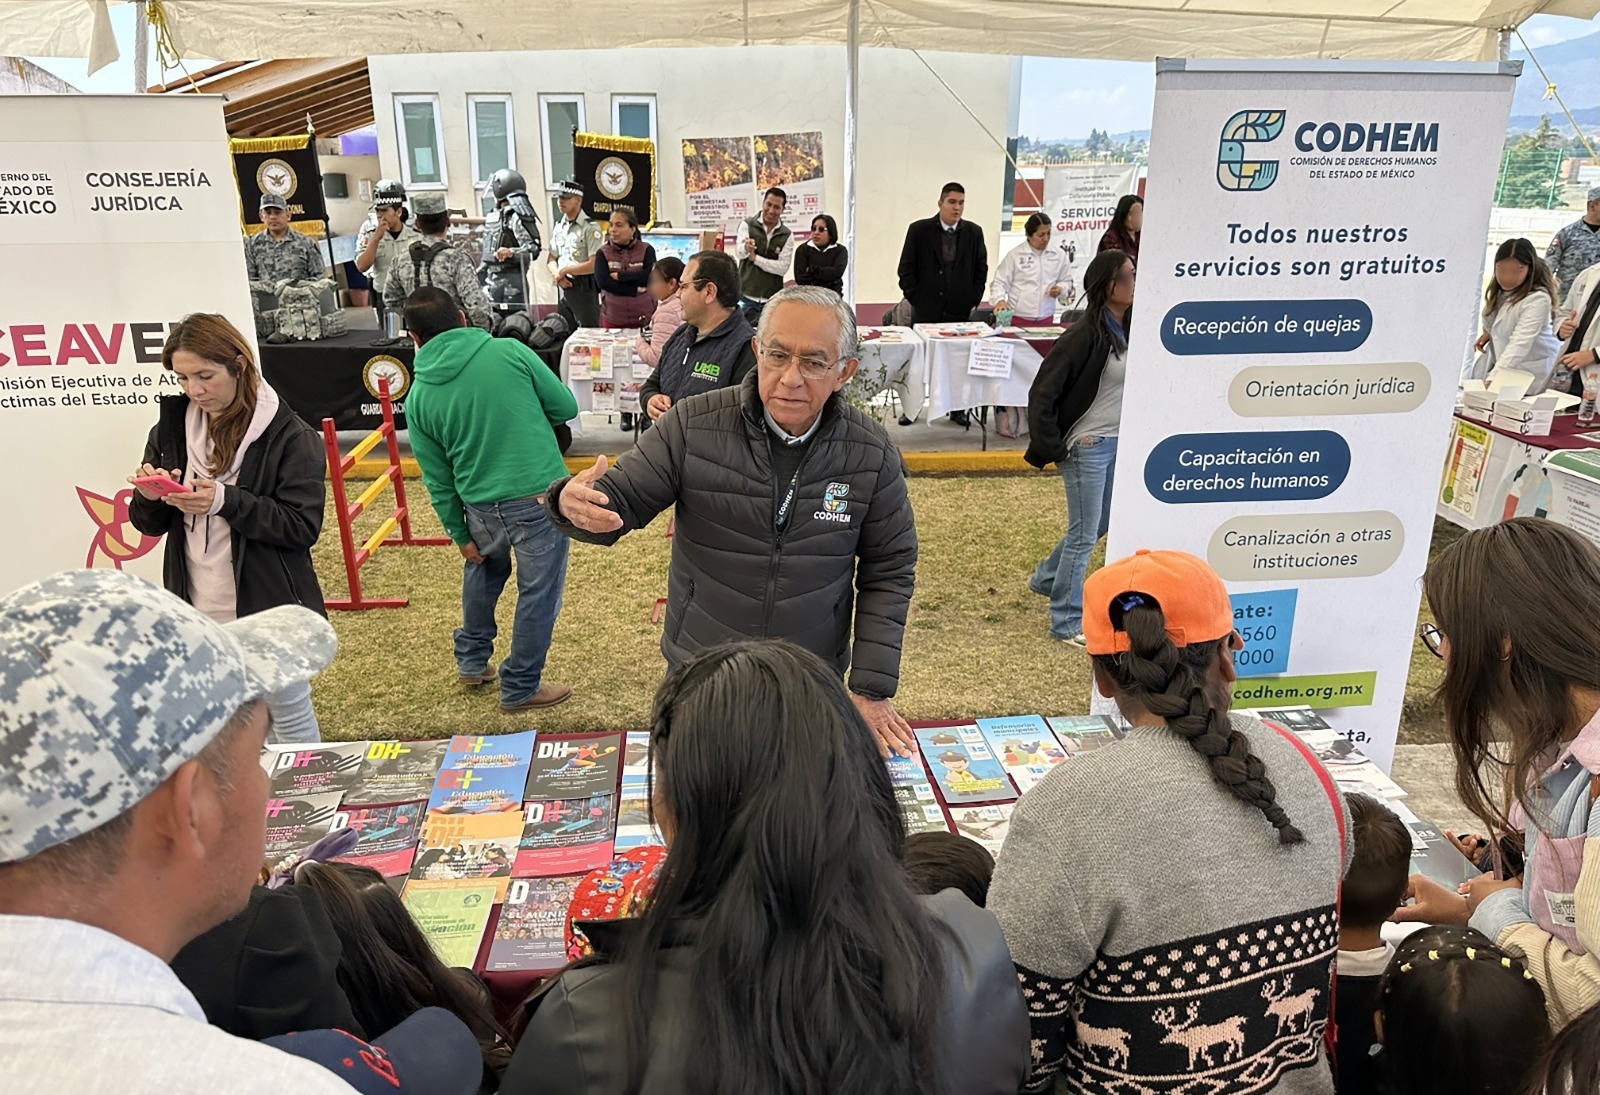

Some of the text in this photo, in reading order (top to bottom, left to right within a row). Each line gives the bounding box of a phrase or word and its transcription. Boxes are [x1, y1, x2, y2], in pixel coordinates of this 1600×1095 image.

[1294, 122, 1439, 152] CODHEM
[1290, 156, 1437, 166] COMISIÓN DE DERECHOS HUMANOS
[32, 173, 51, 181] DEL
[86, 169, 211, 188] CONSEJERÍA
[1309, 168, 1415, 179] DEL ESTADO DE MÉXICO
[0, 185, 54, 196] ADO DE
[90, 193, 183, 211] JURÍDICA
[1227, 221, 1408, 244] Todos nuestros
[1174, 254, 1446, 281] servicios son gratuitos
[1173, 314, 1361, 340] Recepción de quejas
[0, 322, 180, 368] EAVE
[694, 361, 720, 376] UMB
[51, 374, 127, 390] Ejecutiva
[132, 373, 152, 386] de
[1245, 377, 1415, 400] Orientación jurídica
[61, 393, 86, 406] del
[92, 391, 148, 405] Estado
[1178, 447, 1320, 471] Capacitación en
[1163, 473, 1329, 492] derechos humanos
[779, 489, 794, 515] CODHEM
[813, 511, 851, 523] CODHEM
[1224, 527, 1391, 547] Canalización a otras
[1252, 551, 1358, 570] instituciones
[1233, 684, 1363, 700] codhem.org.mx
[537, 742, 574, 759] DH
